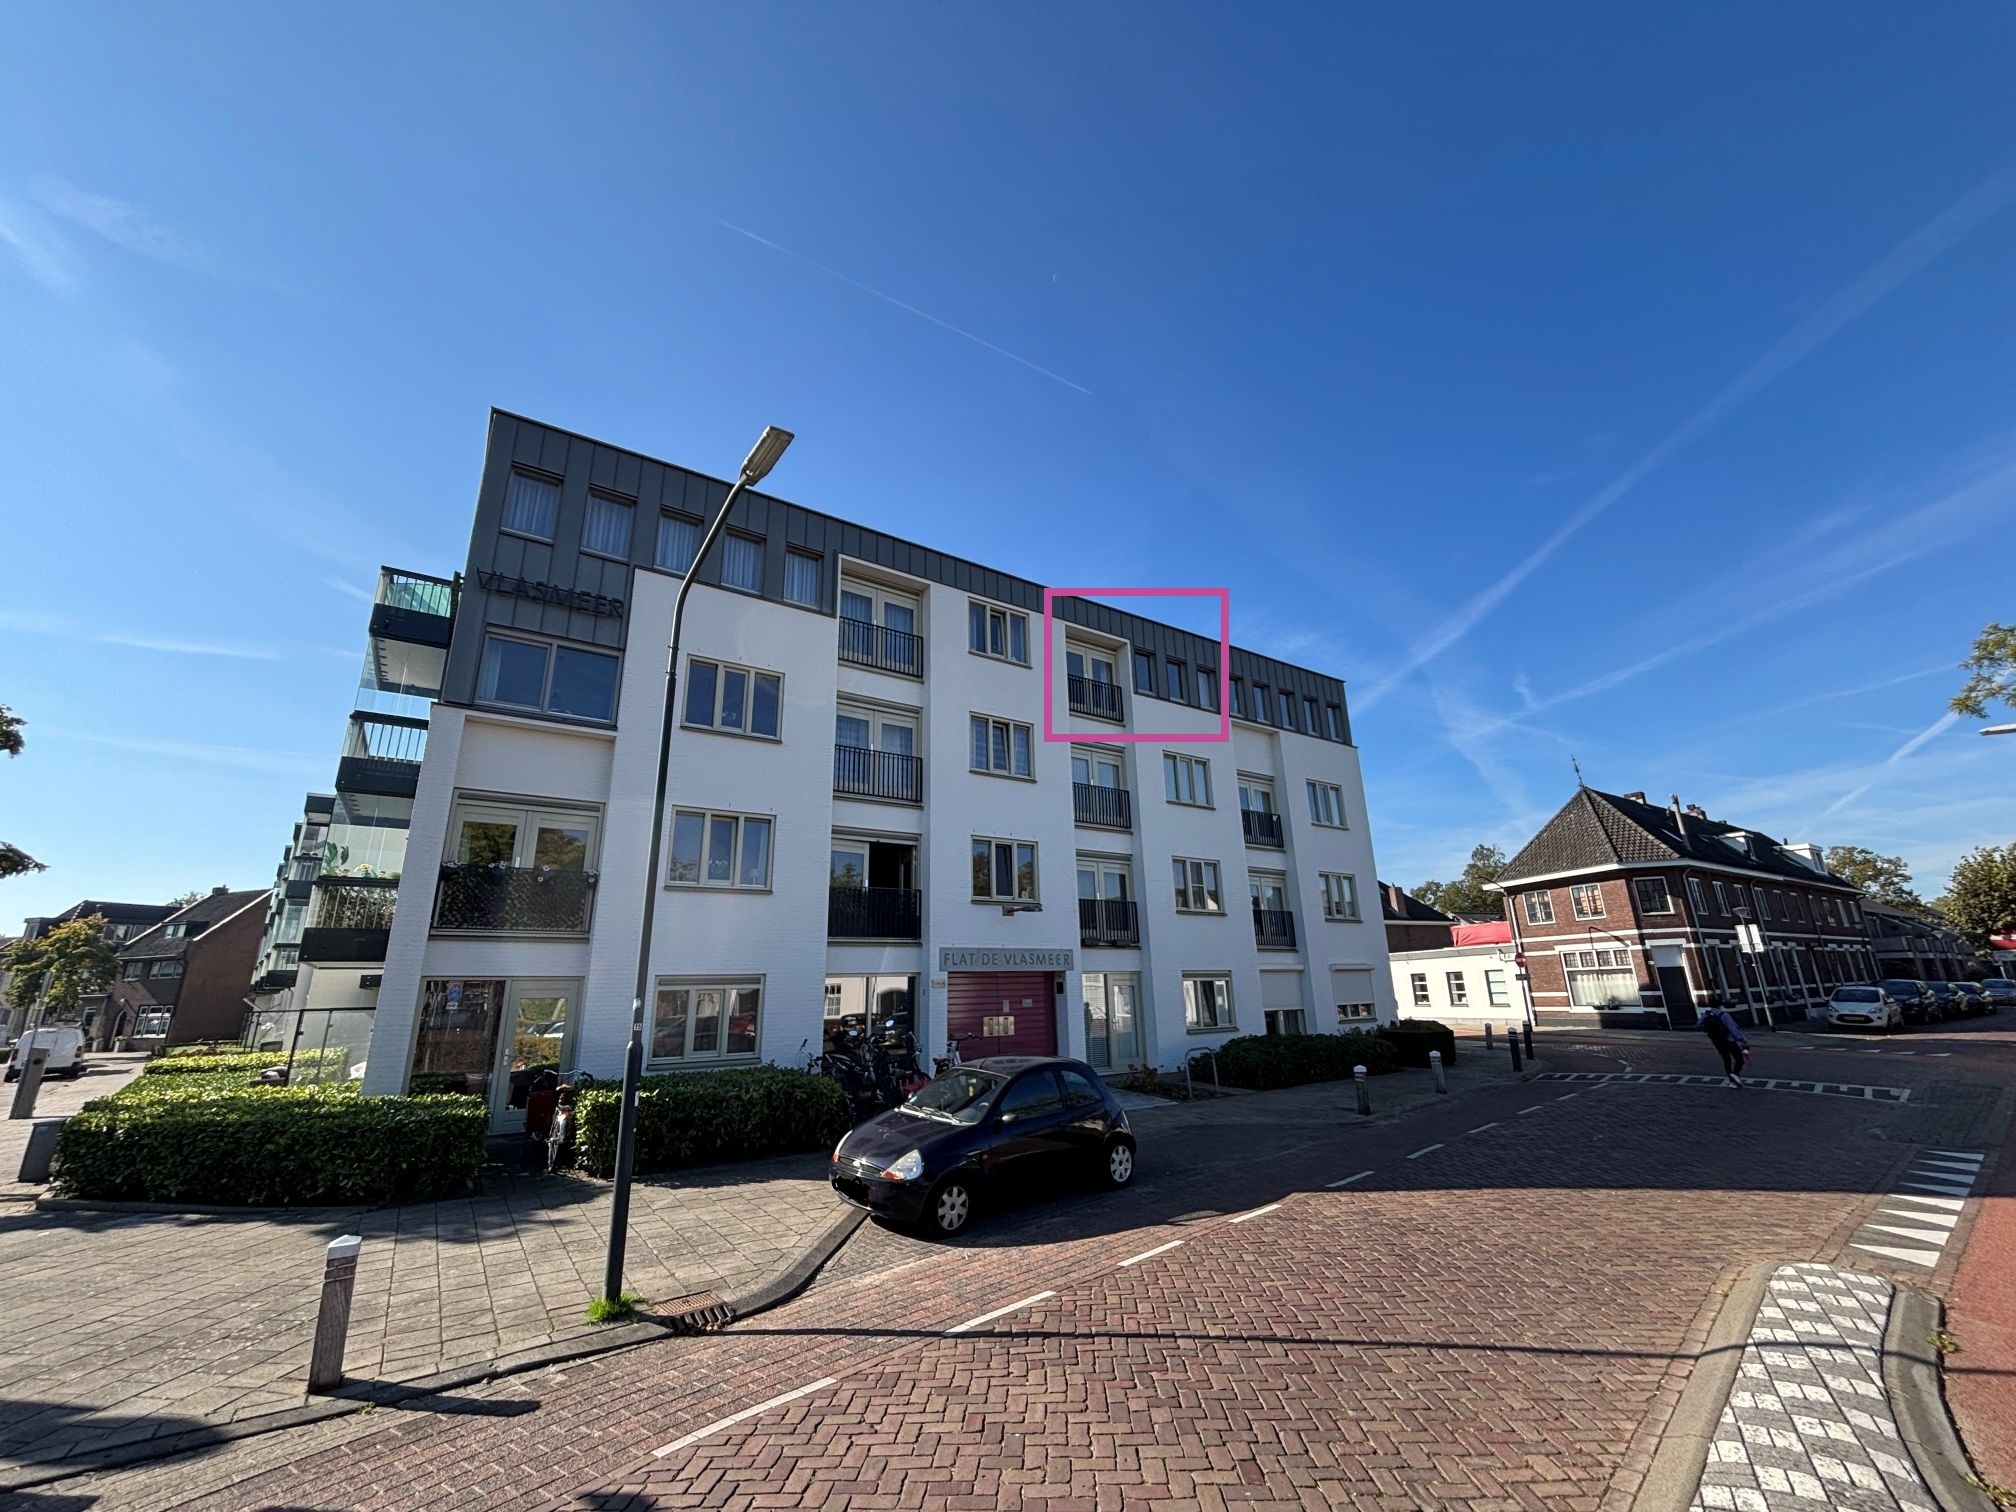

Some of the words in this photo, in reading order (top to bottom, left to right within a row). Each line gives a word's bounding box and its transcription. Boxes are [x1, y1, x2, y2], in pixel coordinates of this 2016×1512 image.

[477, 567, 624, 618] VLASMEER
[944, 953, 975, 966] FLAT
[982, 953, 998, 966] DE
[1004, 953, 1070, 966] VLASMEER
